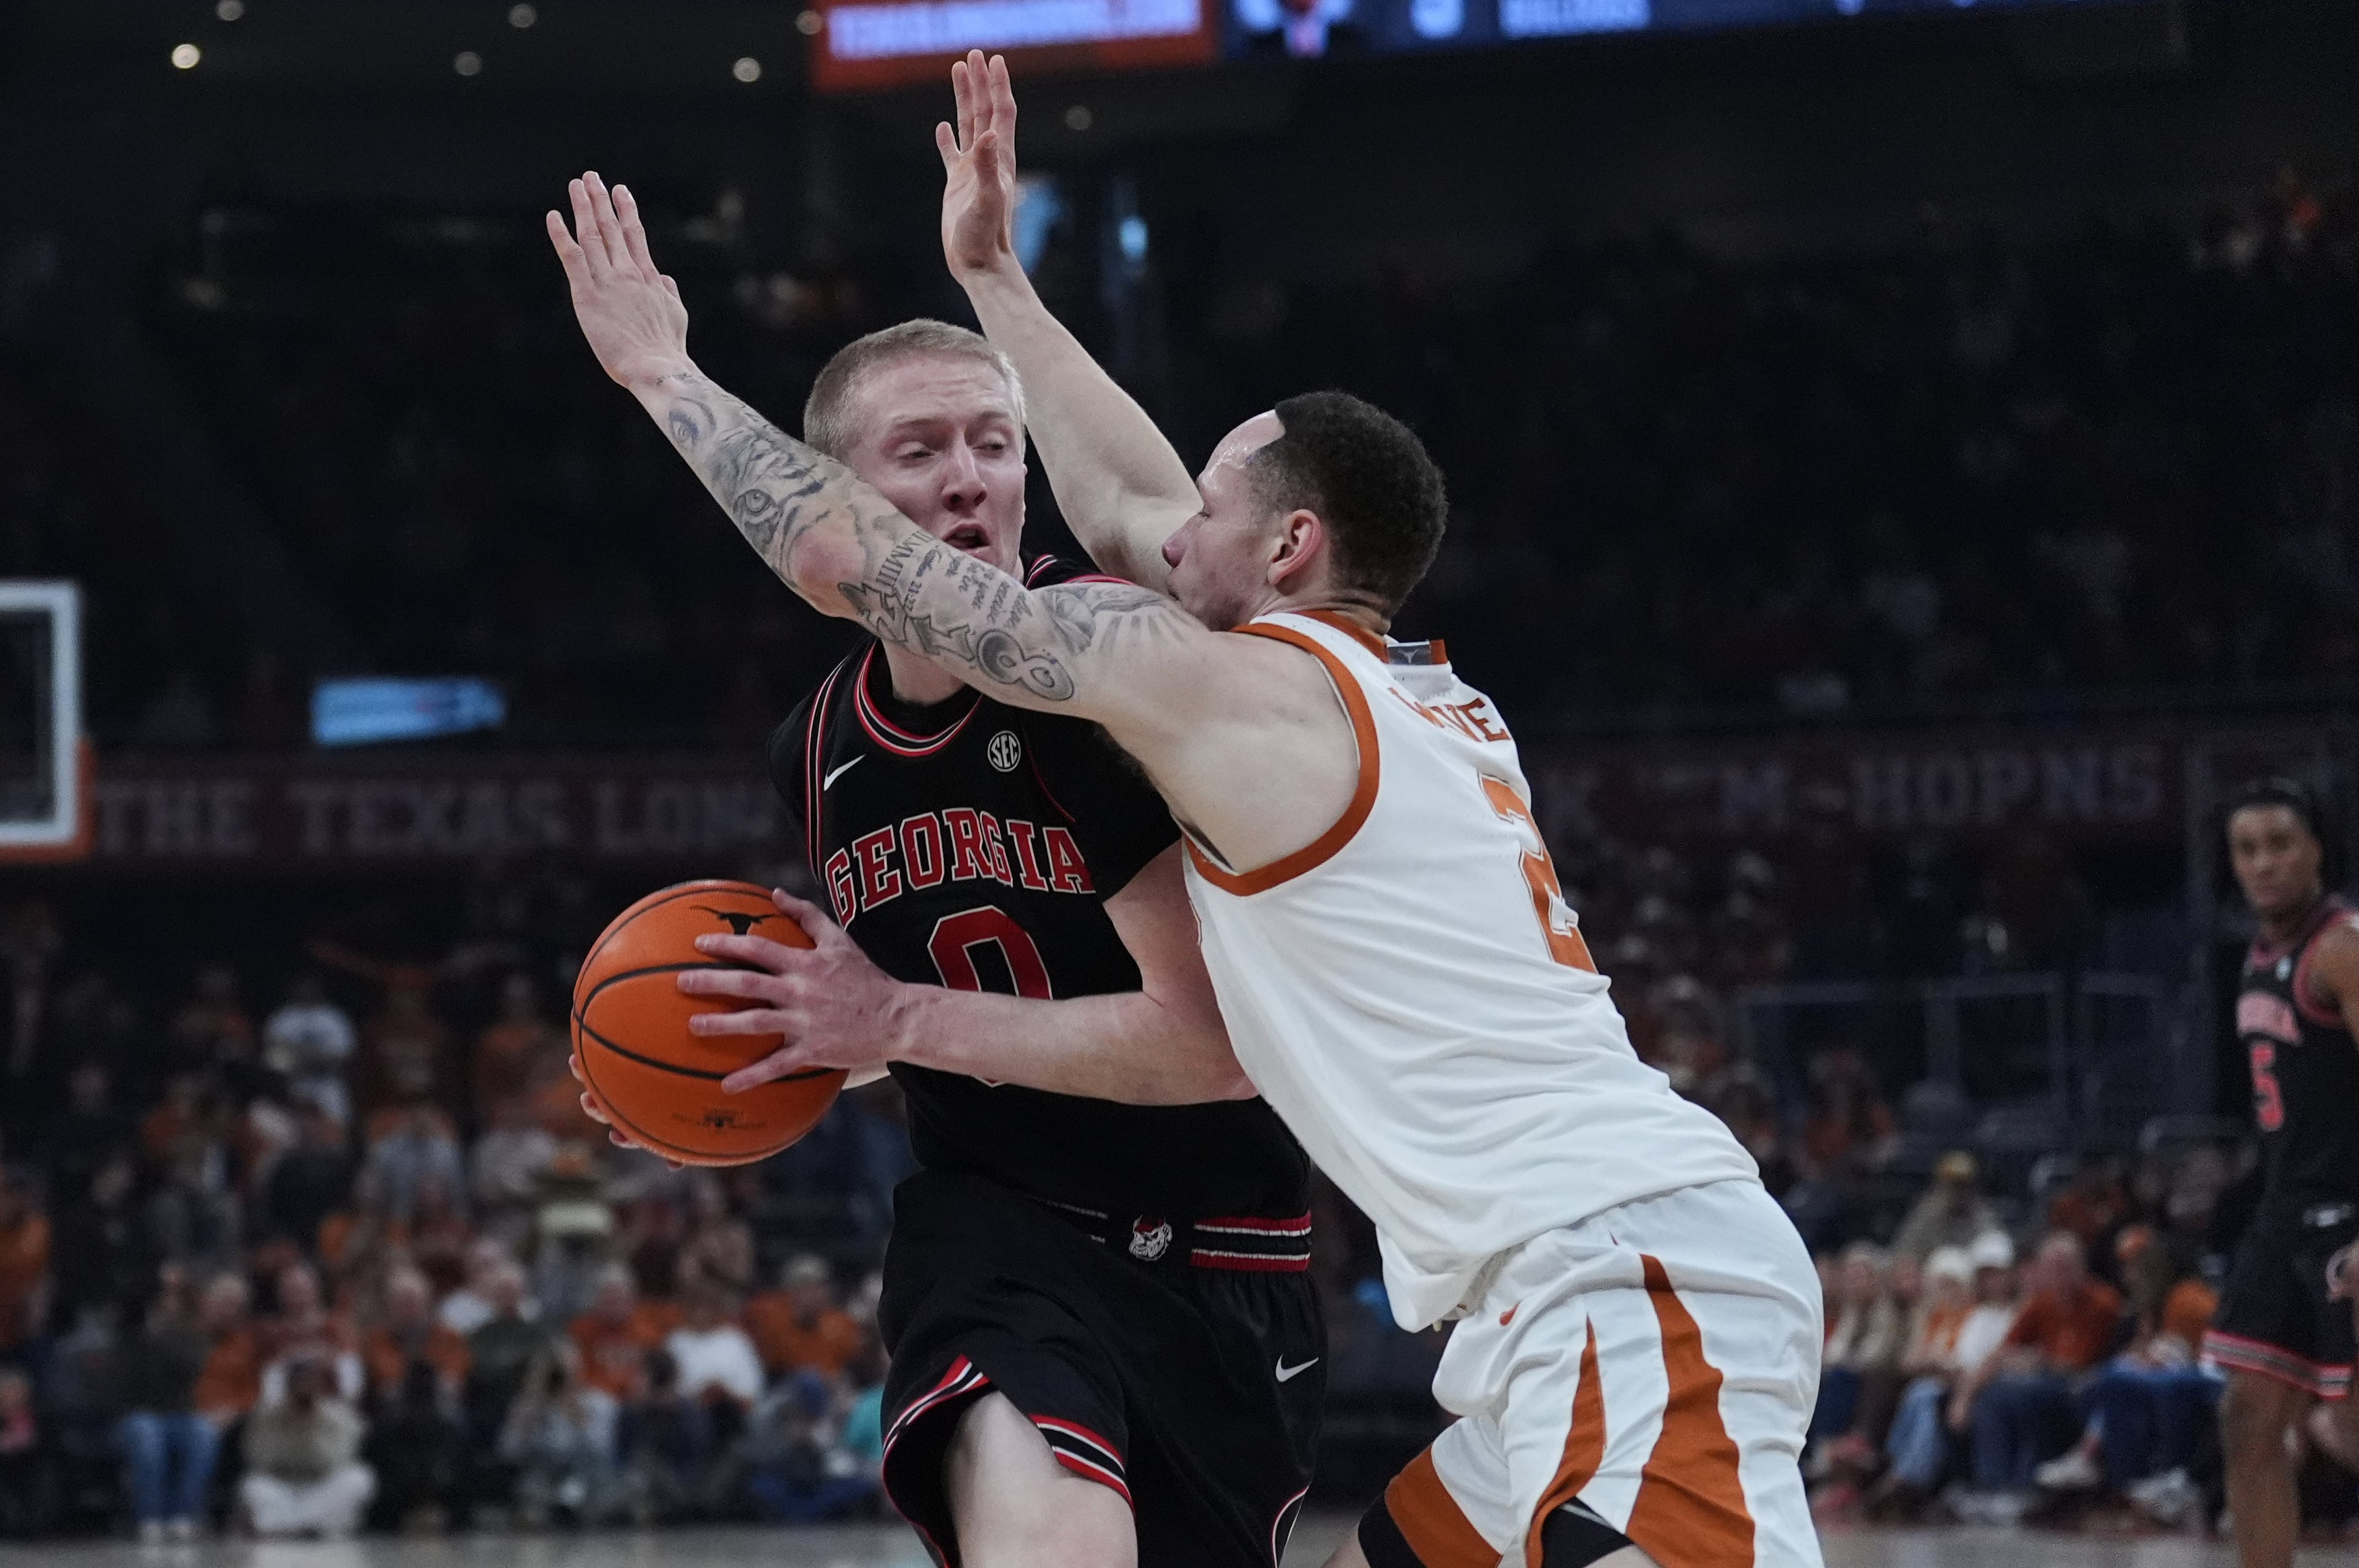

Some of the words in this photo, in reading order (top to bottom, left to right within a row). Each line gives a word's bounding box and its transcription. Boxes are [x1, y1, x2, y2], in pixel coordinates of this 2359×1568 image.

[990, 734, 1019, 768] SEC
[98, 779, 255, 856] THE
[285, 778, 569, 855] TEXAS
[592, 778, 775, 852] LON
[824, 807, 1097, 932] GEORGIA
